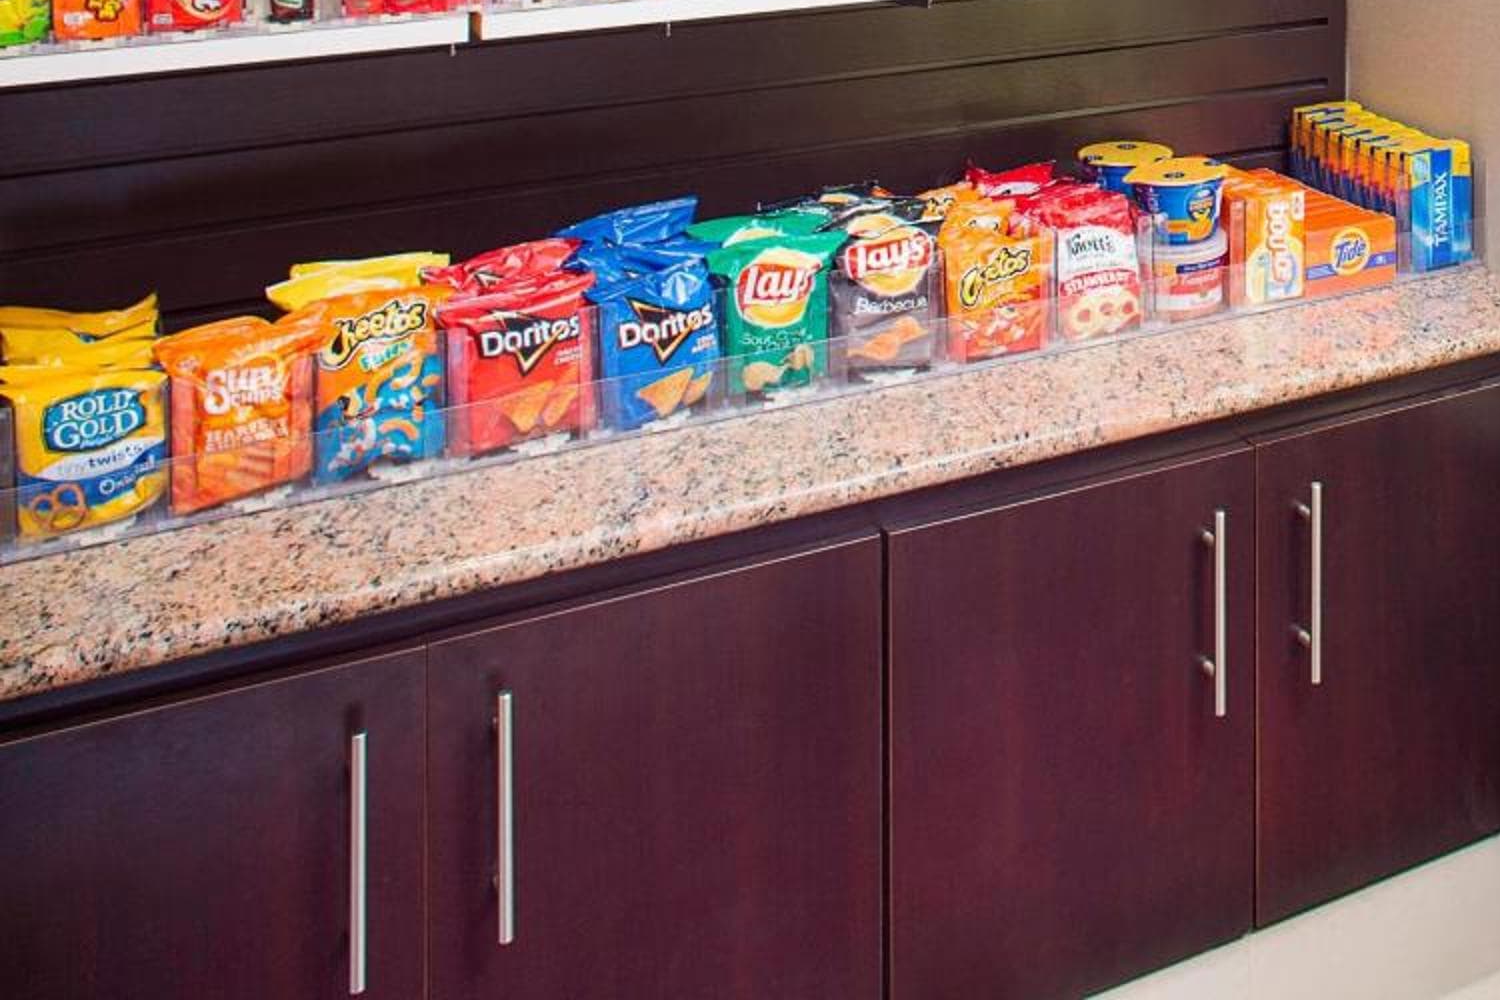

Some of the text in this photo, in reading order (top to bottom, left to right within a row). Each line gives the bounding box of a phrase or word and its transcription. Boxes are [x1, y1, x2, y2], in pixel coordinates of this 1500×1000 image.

[1434, 172, 1448, 247] TAMPAX
[1334, 240, 1366, 265] Tide
[853, 296, 929, 315] Barbecue
[320, 301, 426, 367] Cheetos
[481, 316, 580, 357] Doritos
[619, 304, 713, 348] Doritos
[61, 390, 137, 421] ROLD
[54, 410, 139, 448] GOLD
